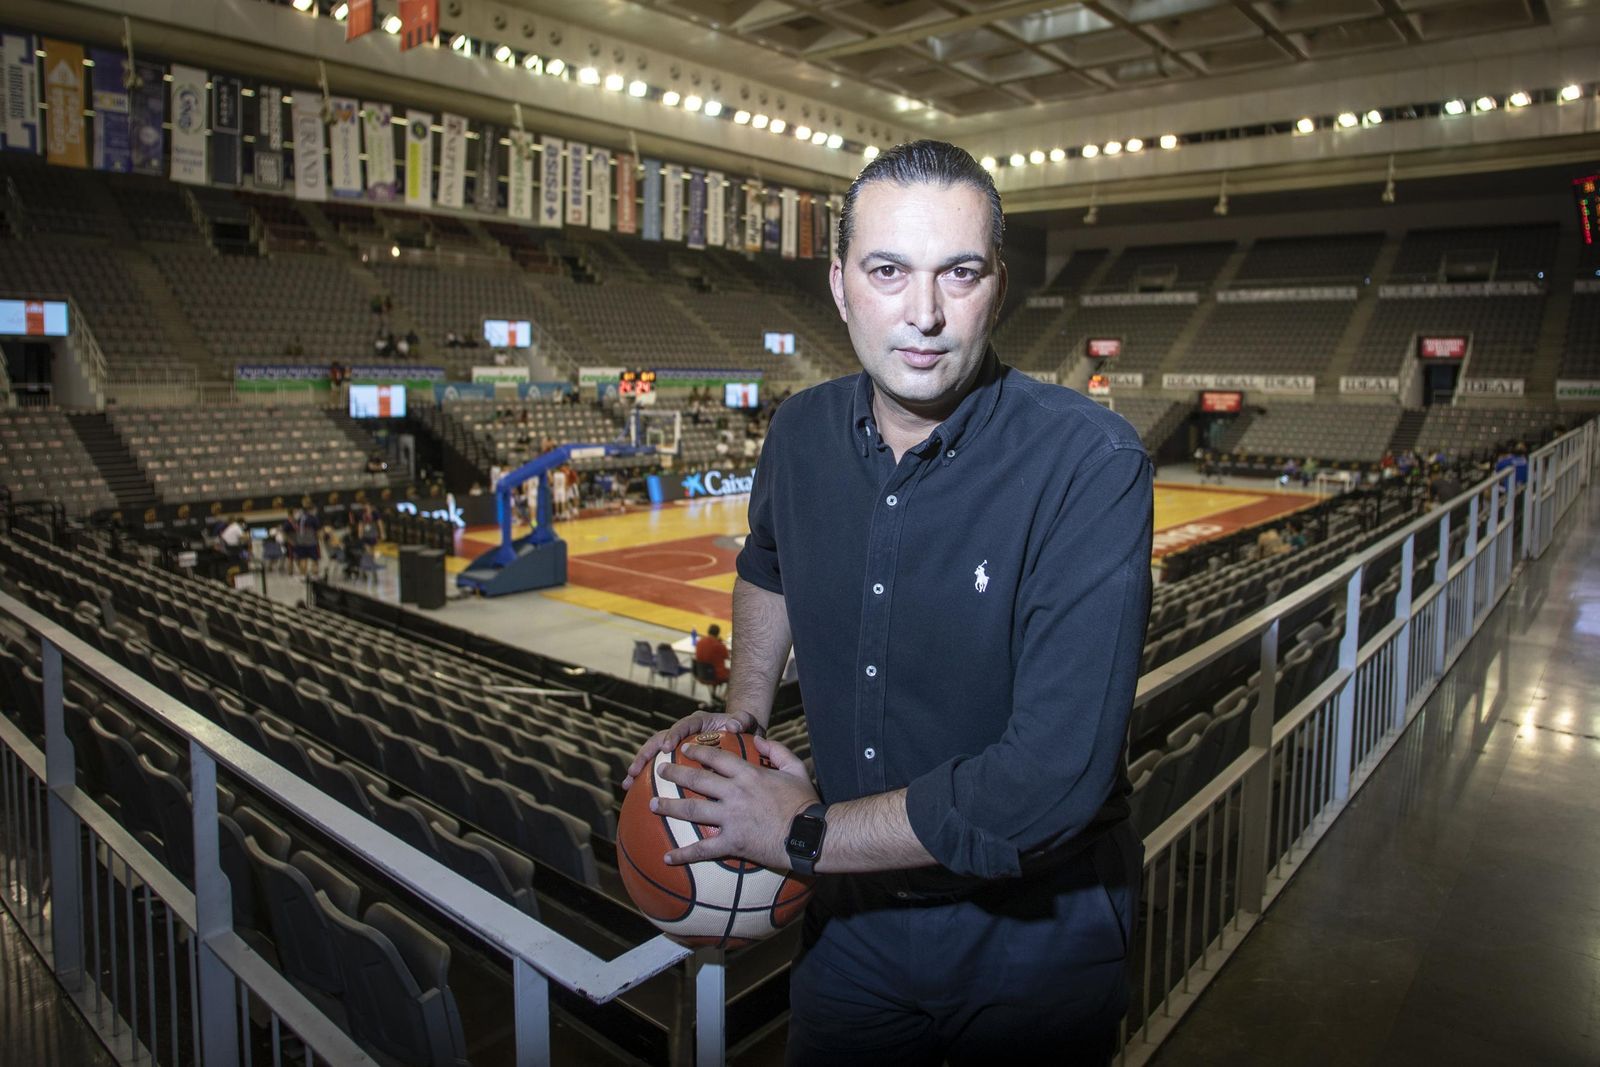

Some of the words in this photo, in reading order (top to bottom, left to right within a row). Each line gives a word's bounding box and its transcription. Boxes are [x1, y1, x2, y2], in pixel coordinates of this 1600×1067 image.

[1344, 378, 1396, 390] IDEAL
[1463, 381, 1520, 394] IDEAL
[704, 467, 756, 496] Caixa
